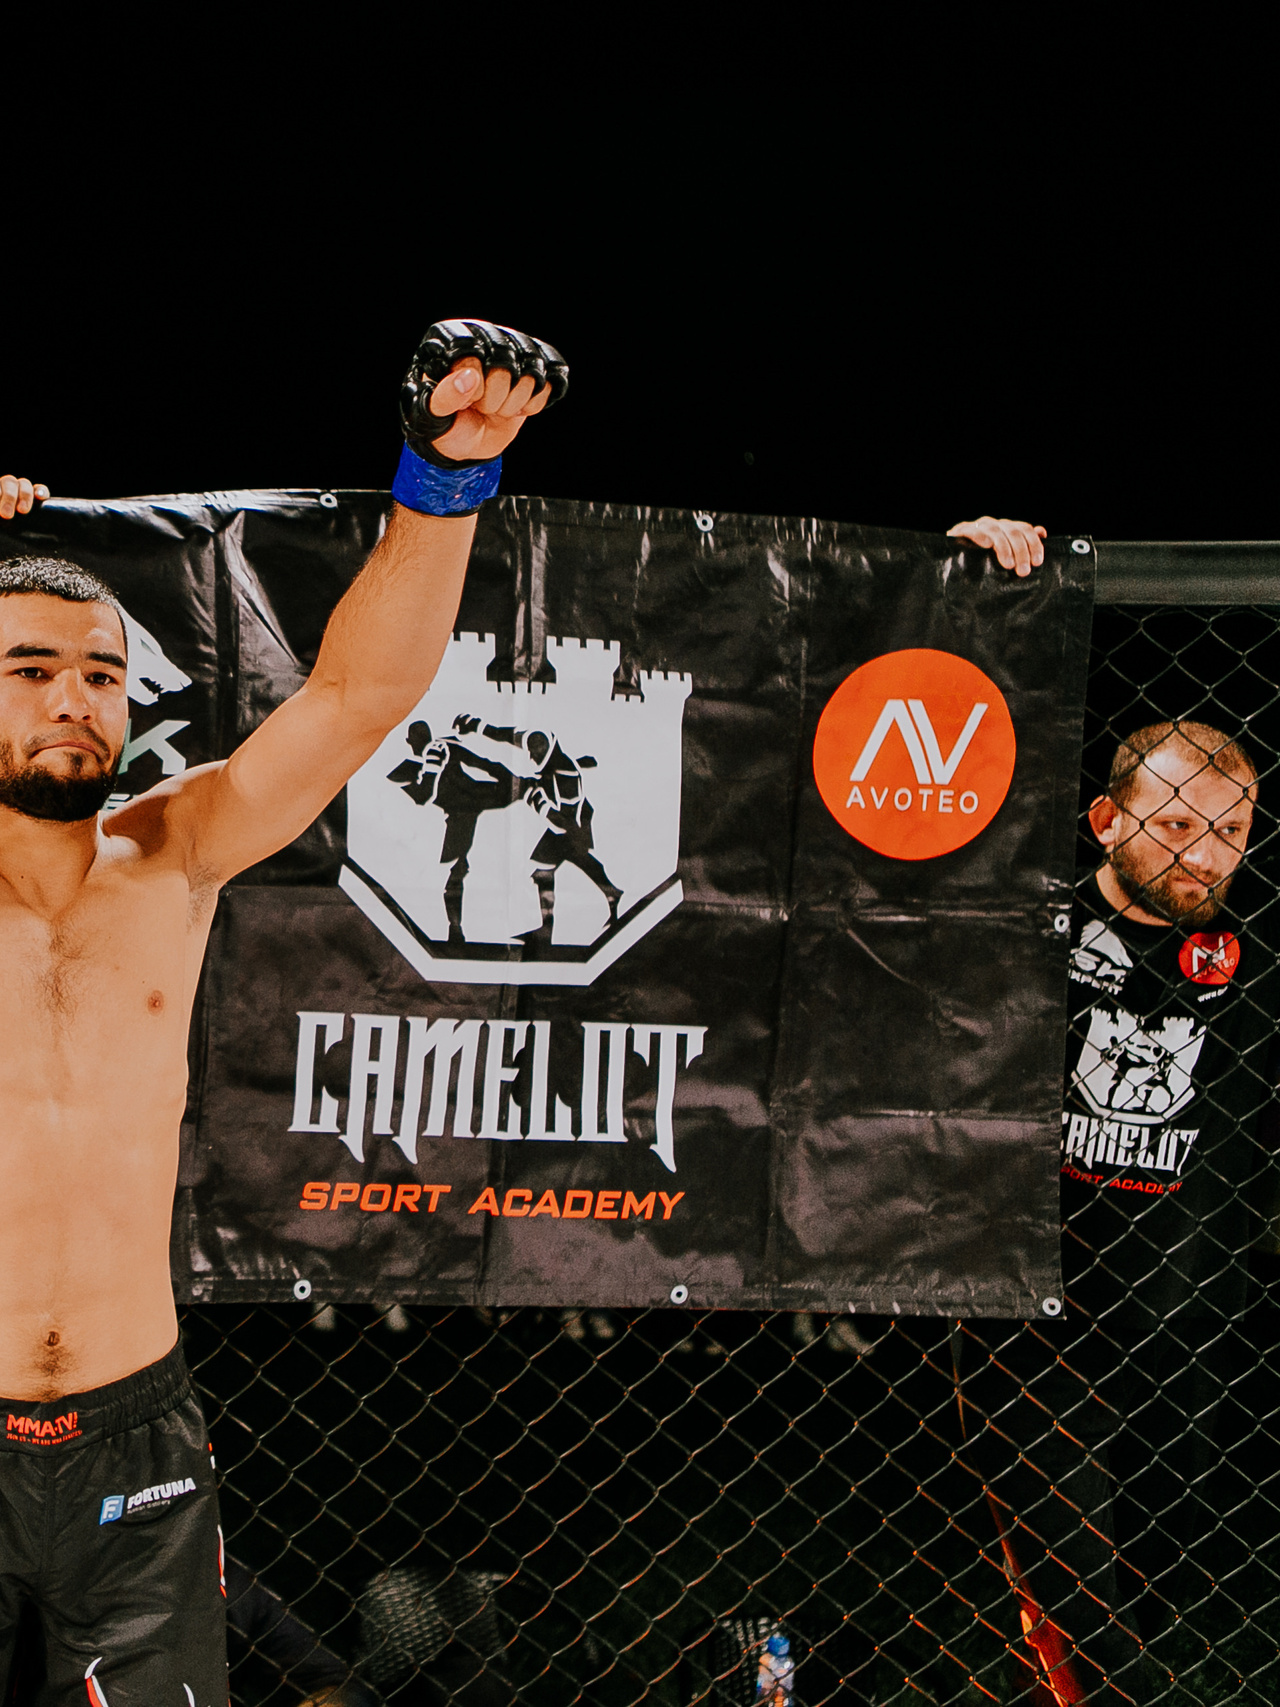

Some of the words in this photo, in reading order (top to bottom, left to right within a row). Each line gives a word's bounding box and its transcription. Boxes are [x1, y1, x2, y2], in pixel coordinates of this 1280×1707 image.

[846, 785, 979, 814] AVOTEO
[287, 1011, 709, 1173] CAMELOT
[299, 1182, 451, 1213] SPORT
[468, 1187, 685, 1220] ACADEMY
[127, 1477, 196, 1510] FORTUNA
